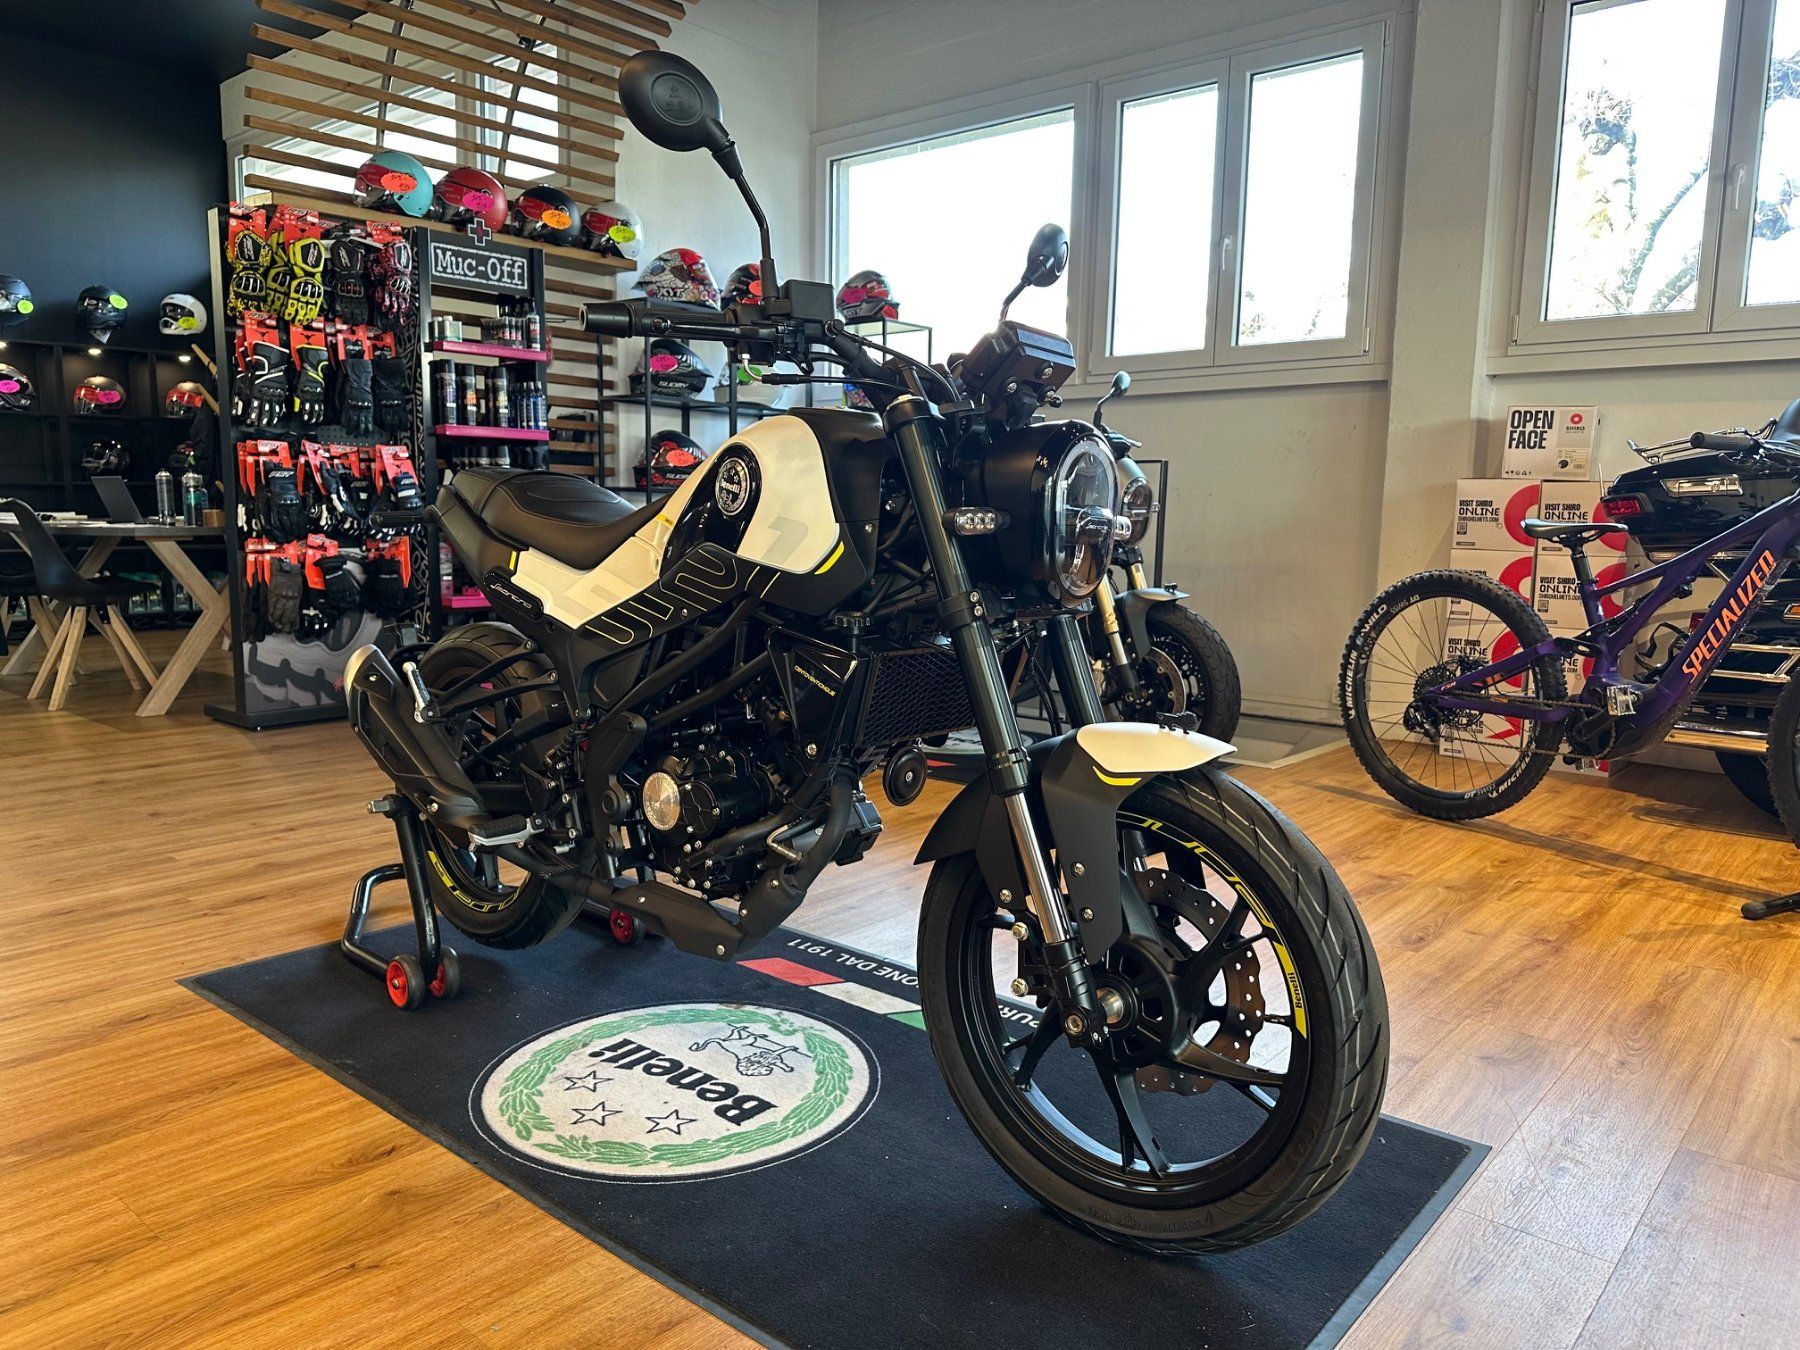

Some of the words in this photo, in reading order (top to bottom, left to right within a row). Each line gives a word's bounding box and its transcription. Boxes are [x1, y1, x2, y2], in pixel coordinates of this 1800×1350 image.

[436, 248, 523, 285] Muc-Off
[1510, 409, 1555, 430] OPEN
[1508, 430, 1548, 450] FACE
[1458, 507, 1500, 516] ONLINE
[1544, 503, 1560, 511] VISIT
[1544, 511, 1588, 520] ONLINE
[1540, 576, 1556, 584] VISIT
[1540, 585, 1580, 594] ONLIN
[1681, 549, 1777, 684] SPECIALIZED
[1448, 645, 1488, 656] ONLINE
[1345, 649, 1358, 708] MICHELIN
[786, 938, 834, 958] 1911
[836, 953, 877, 971] DAL
[1287, 972, 1304, 1010] Benelli
[588, 1038, 779, 1127] Benelli
